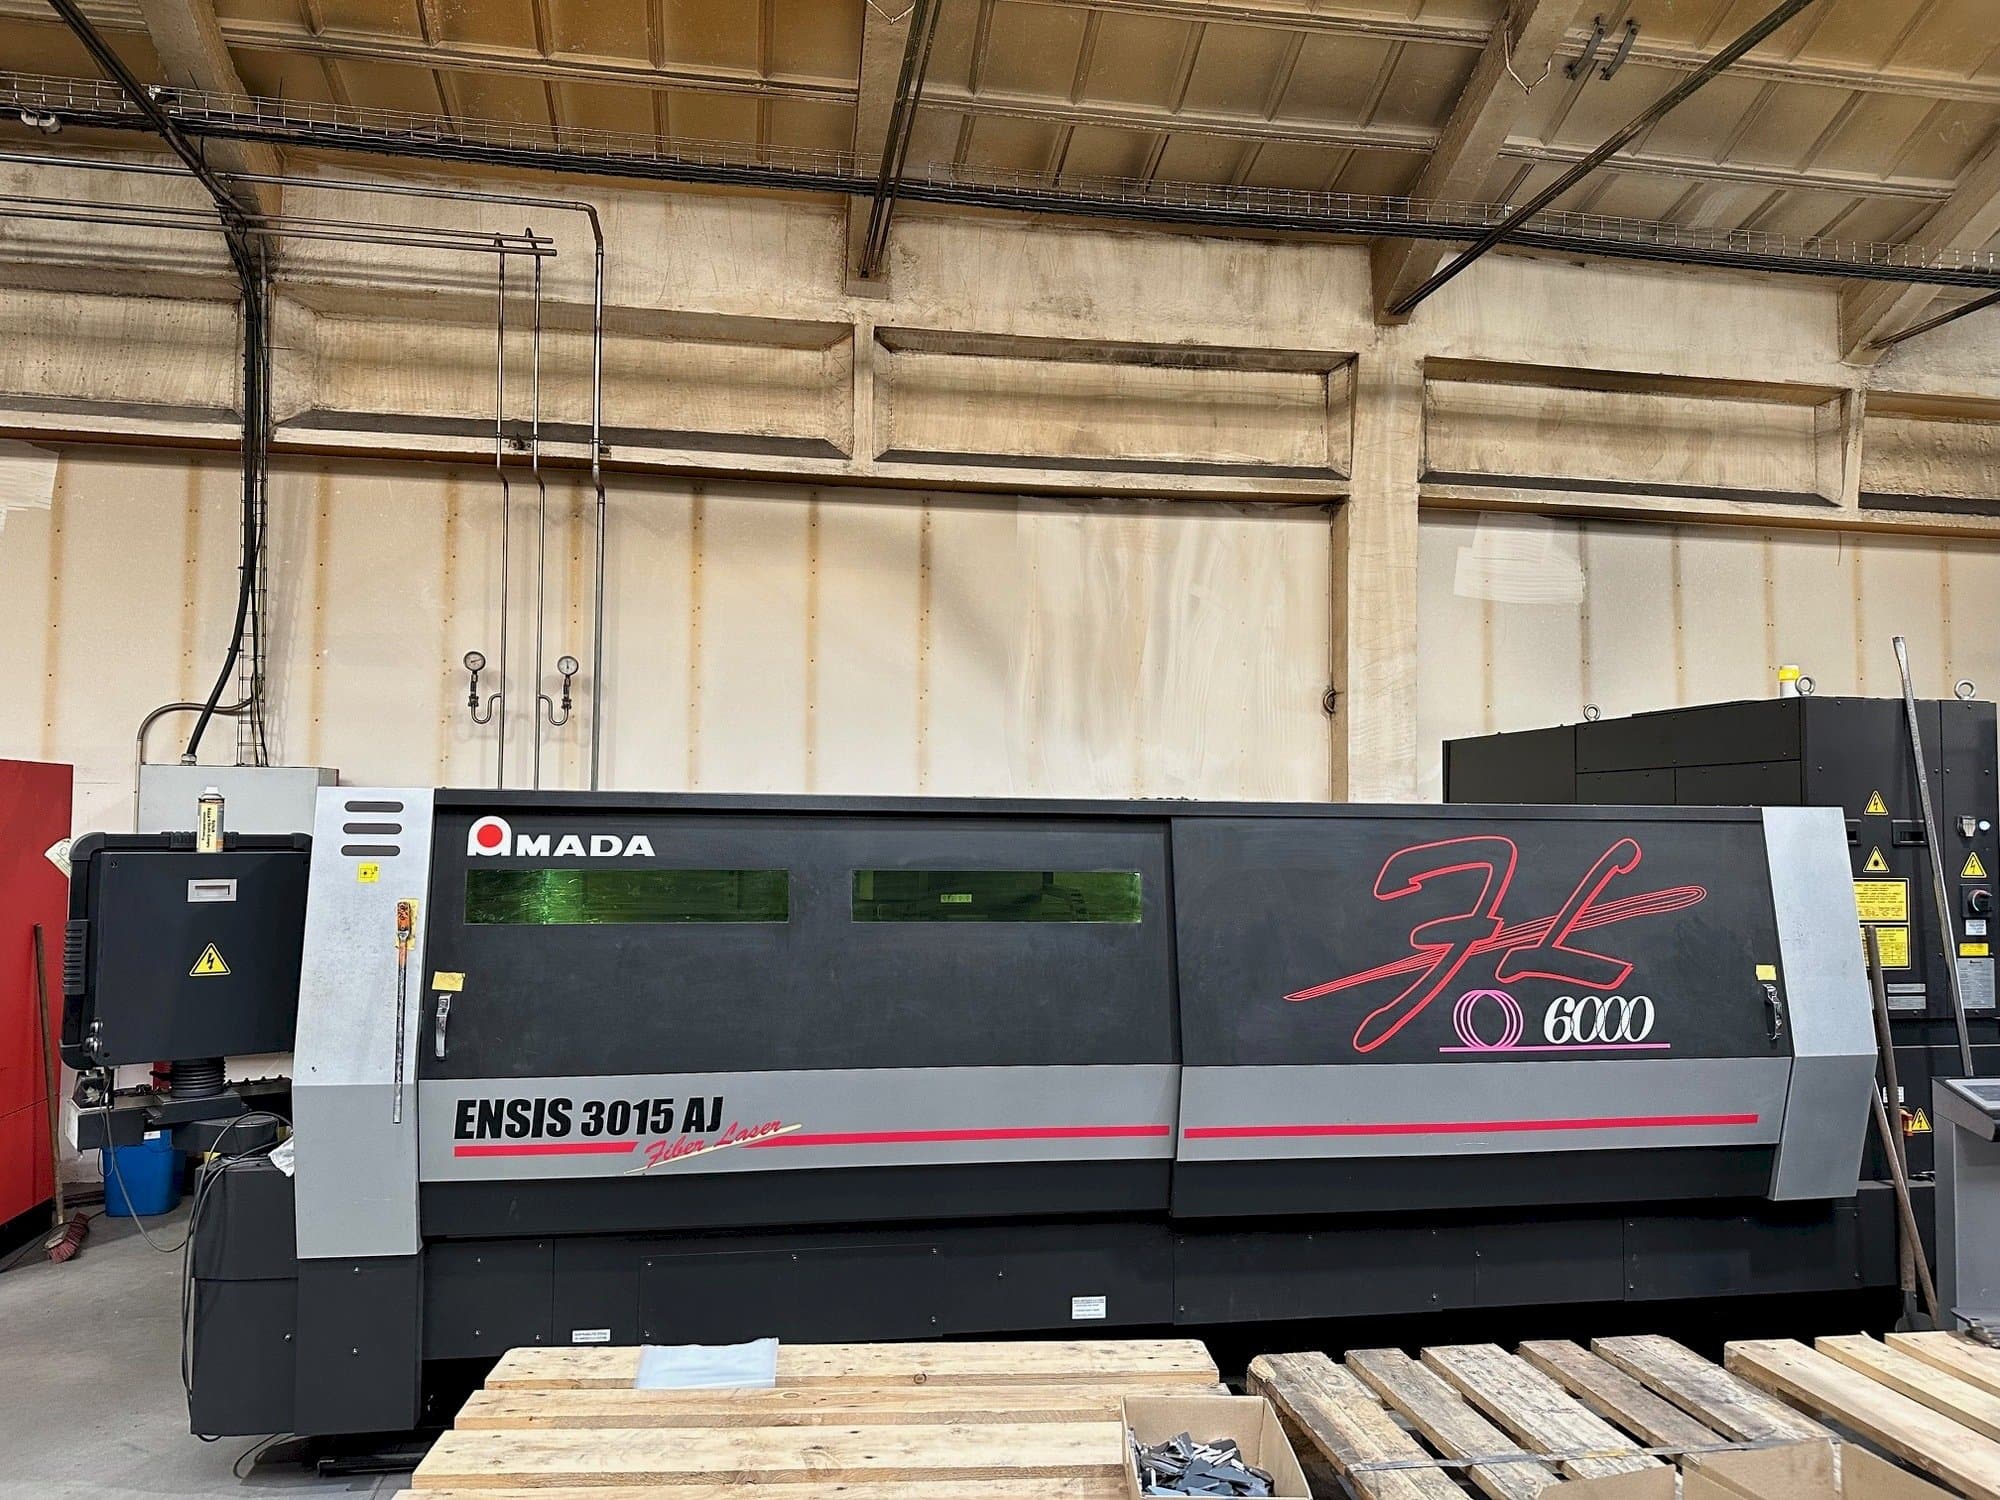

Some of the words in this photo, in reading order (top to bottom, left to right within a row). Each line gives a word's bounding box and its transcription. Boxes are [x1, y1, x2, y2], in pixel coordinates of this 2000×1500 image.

[467, 815, 656, 857] AMADA
[1543, 995, 1655, 1044] 6000
[454, 1097, 572, 1140] ENSIS
[580, 1097, 674, 1137] 3015
[681, 1096, 724, 1133] AJ
[644, 1135, 705, 1168] Fiber
[714, 1120, 782, 1148] Laser
